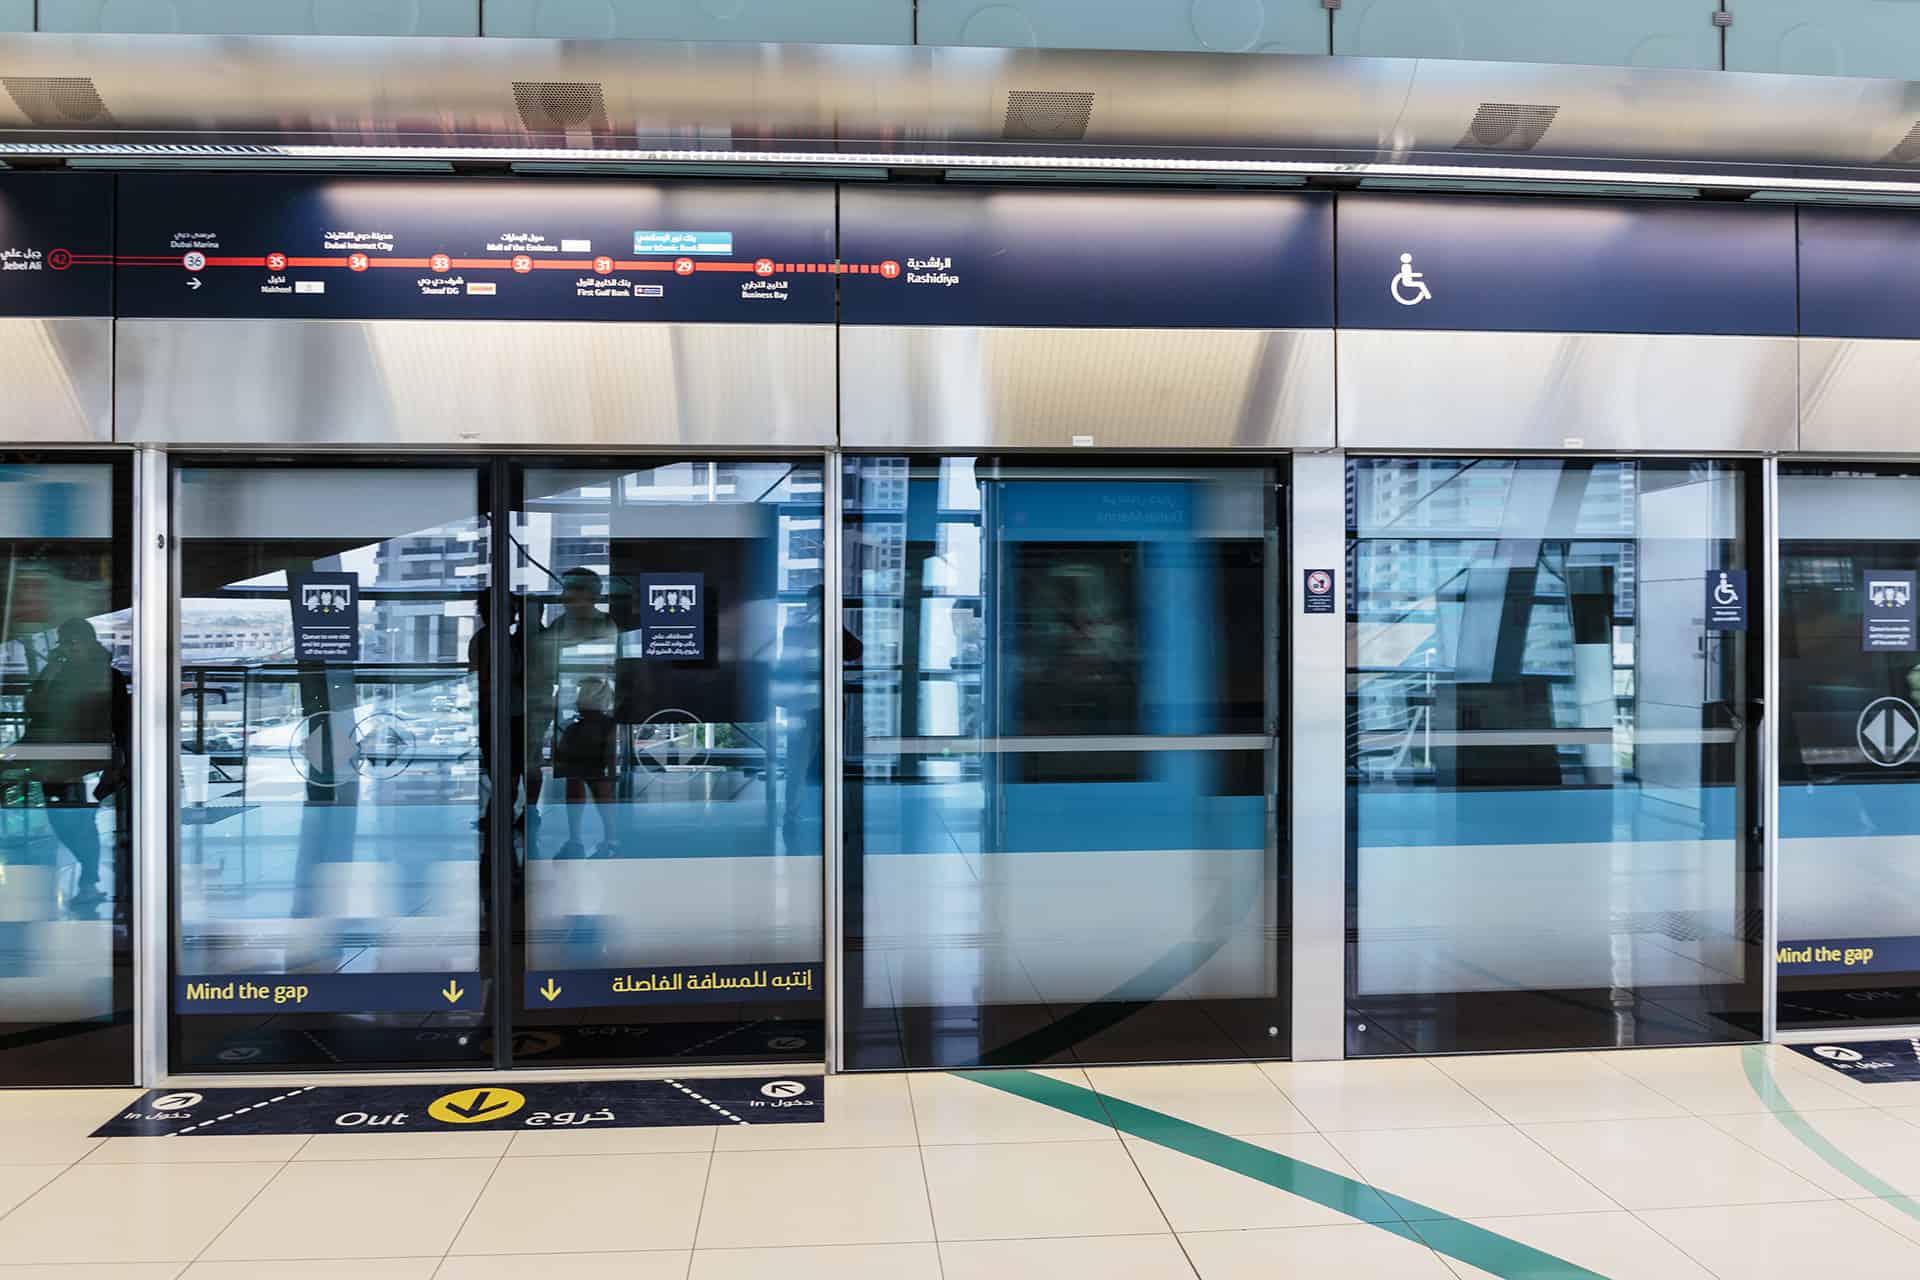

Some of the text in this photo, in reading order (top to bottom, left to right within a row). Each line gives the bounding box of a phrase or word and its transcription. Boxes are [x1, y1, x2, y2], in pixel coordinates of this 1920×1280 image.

[324, 241, 393, 251] Dubai Internet City
[486, 243, 503, 251] Mall
[3, 261, 42, 270] Jebel Ali
[188, 255, 202, 267] 36
[268, 256, 284, 268] 35
[351, 256, 367, 269] 34
[432, 257, 448, 269] 33
[514, 258, 529, 270] 32
[596, 258, 610, 270] 31
[677, 260, 692, 271] 29
[757, 261, 772, 273] 26
[906, 257, 952, 269] الراشدية
[884, 264, 896, 275] 11
[906, 273, 960, 286] Rashidiya
[446, 287, 460, 295] DG
[577, 289, 630, 297] First Gulf Bank
[742, 291, 788, 300] Business Bay
[1776, 946, 1873, 966] Mind the gap
[612, 968, 812, 992] إنتبه للمسافة الفاصلة
[186, 983, 309, 1004] Mind the gap
[750, 1099, 765, 1107] In
[334, 1111, 409, 1126] Out
[525, 1108, 616, 1126] خروج
